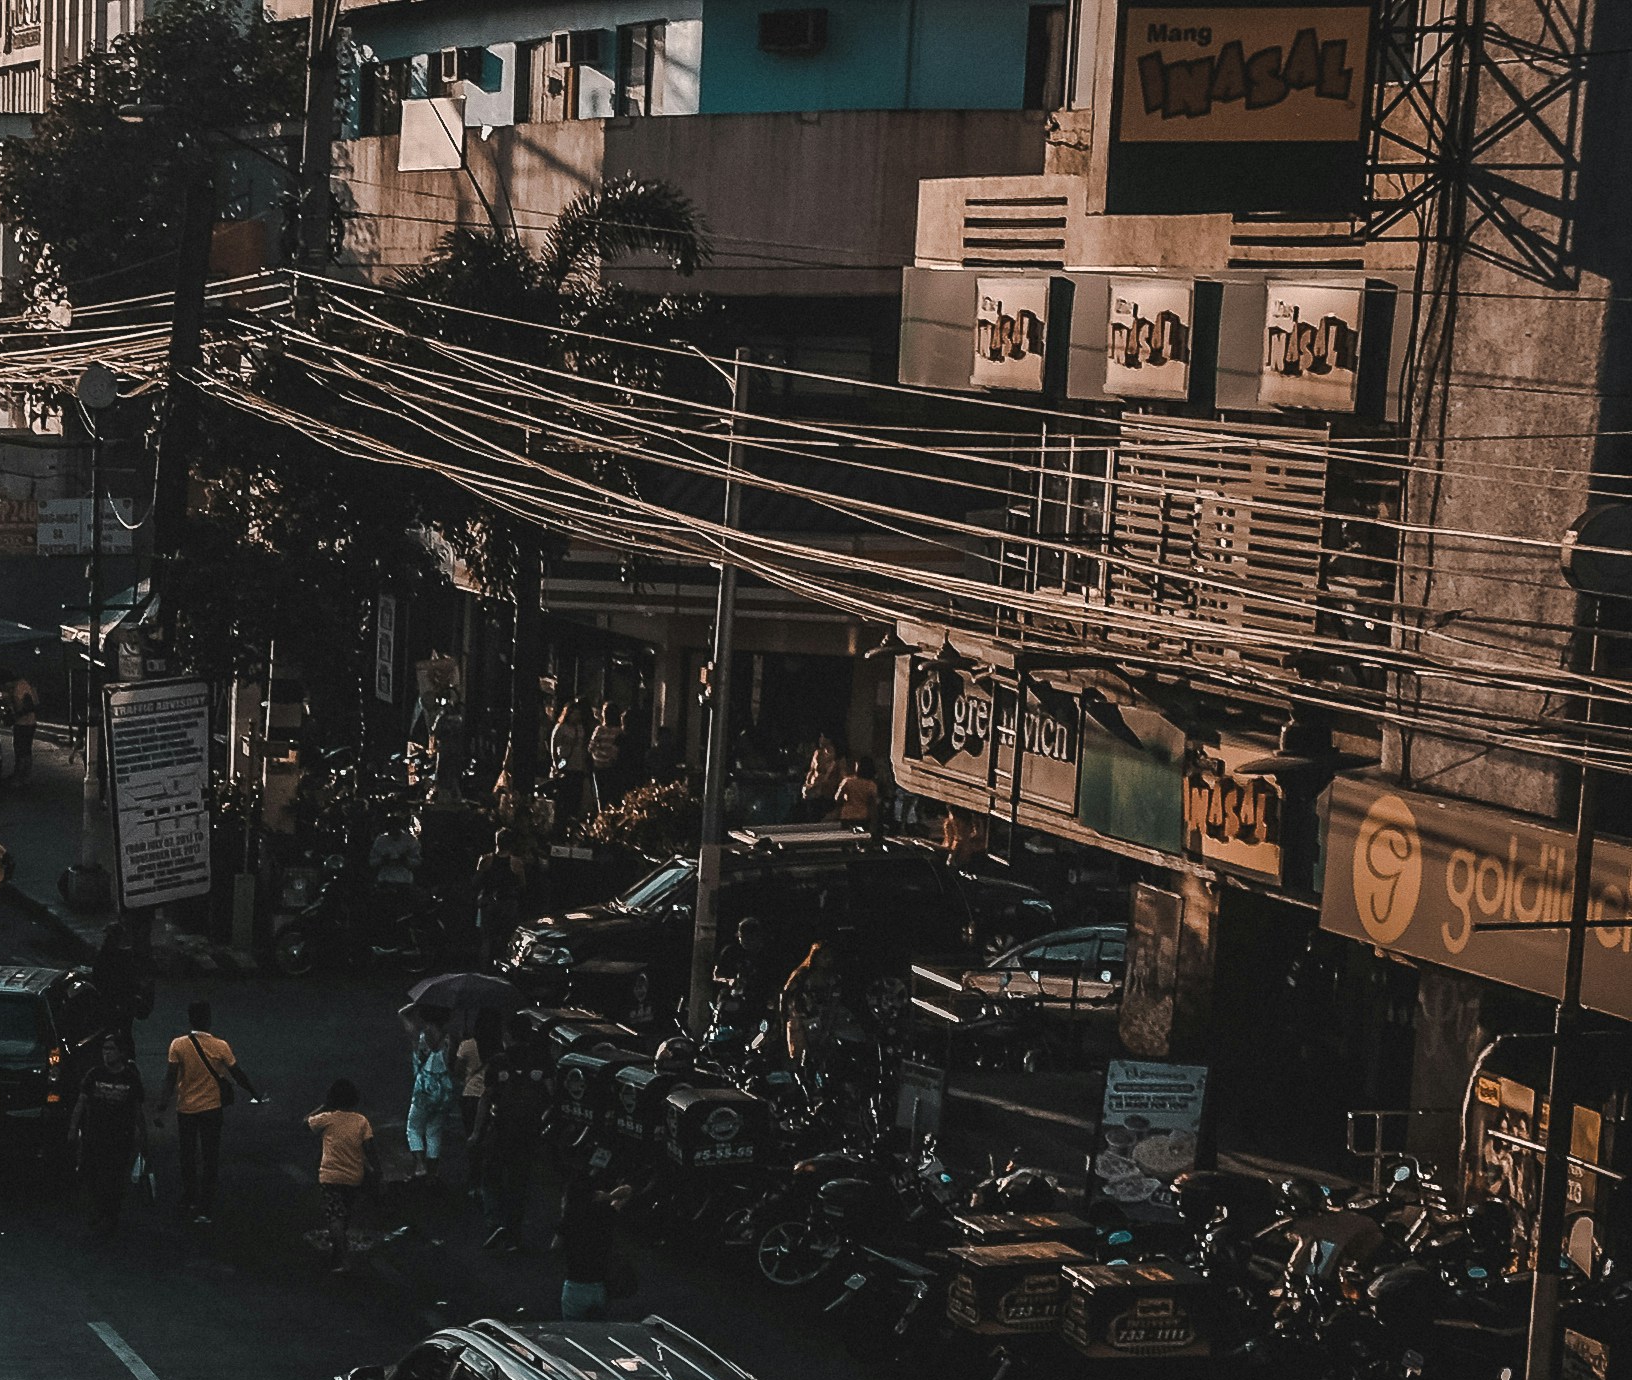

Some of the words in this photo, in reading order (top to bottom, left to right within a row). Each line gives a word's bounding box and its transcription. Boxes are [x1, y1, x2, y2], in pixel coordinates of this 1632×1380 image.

[1147, 23, 1212, 47] Mang
[1137, 27, 1353, 120] INASAL
[113, 702, 154, 717] TRAFFIC
[156, 696, 206, 712] ADVISORY
